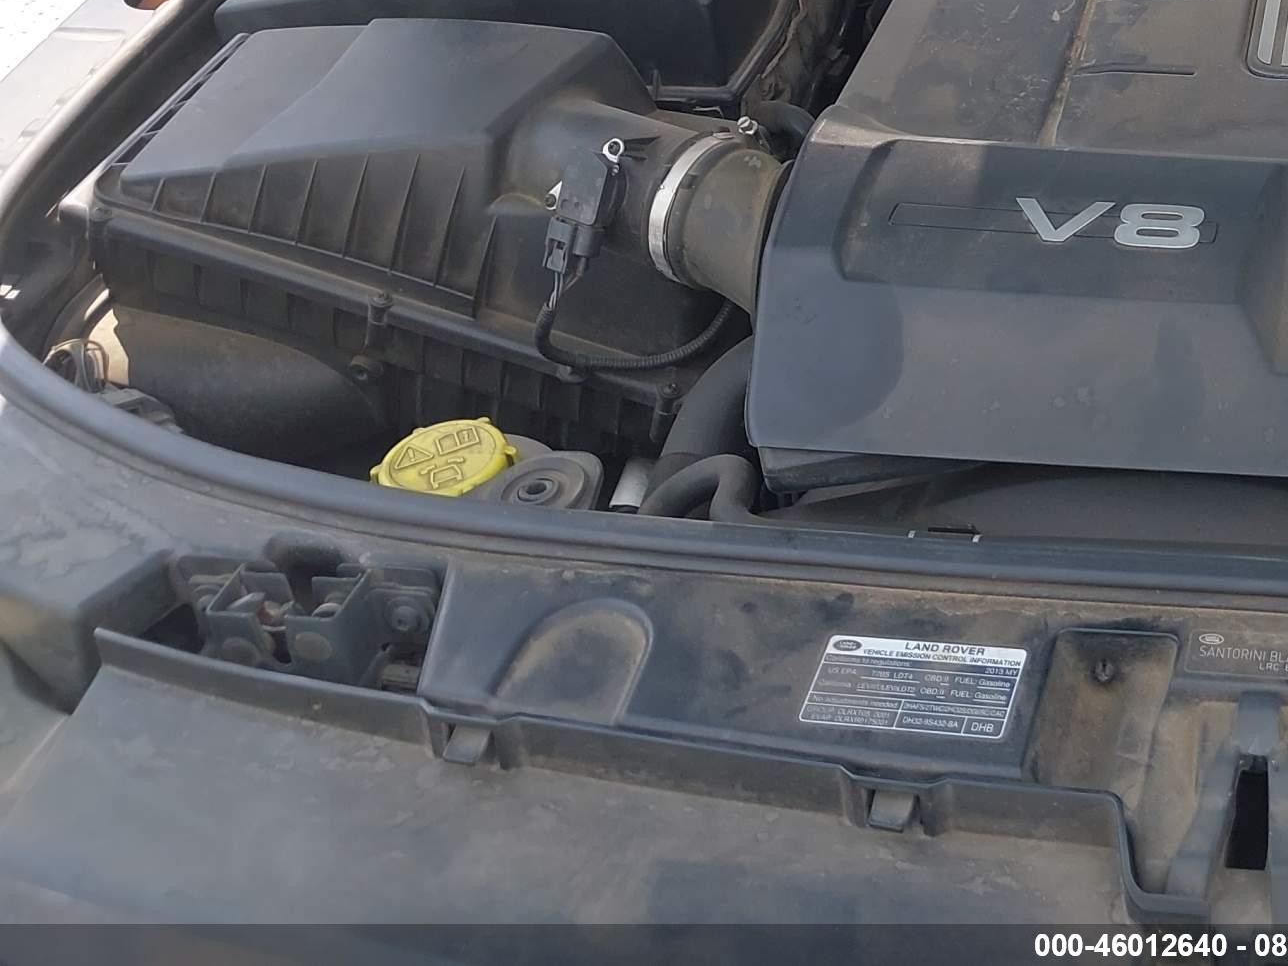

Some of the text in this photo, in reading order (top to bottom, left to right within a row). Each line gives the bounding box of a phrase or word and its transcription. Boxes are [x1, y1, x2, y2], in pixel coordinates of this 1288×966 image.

[1015, 197, 1206, 249] V8
[904, 641, 986, 656] LAND ROVER
[1199, 645, 1267, 661] SANTORINI
[863, 649, 1021, 667] VEHICLE EMISSION CONTROL INFORMATION
[984, 667, 1003, 675] 2013
[1258, 662, 1279, 672] LRC
[978, 679, 1011, 687] Gasoline
[974, 692, 1008, 700] Gasoline
[970, 721, 995, 732] DHB
